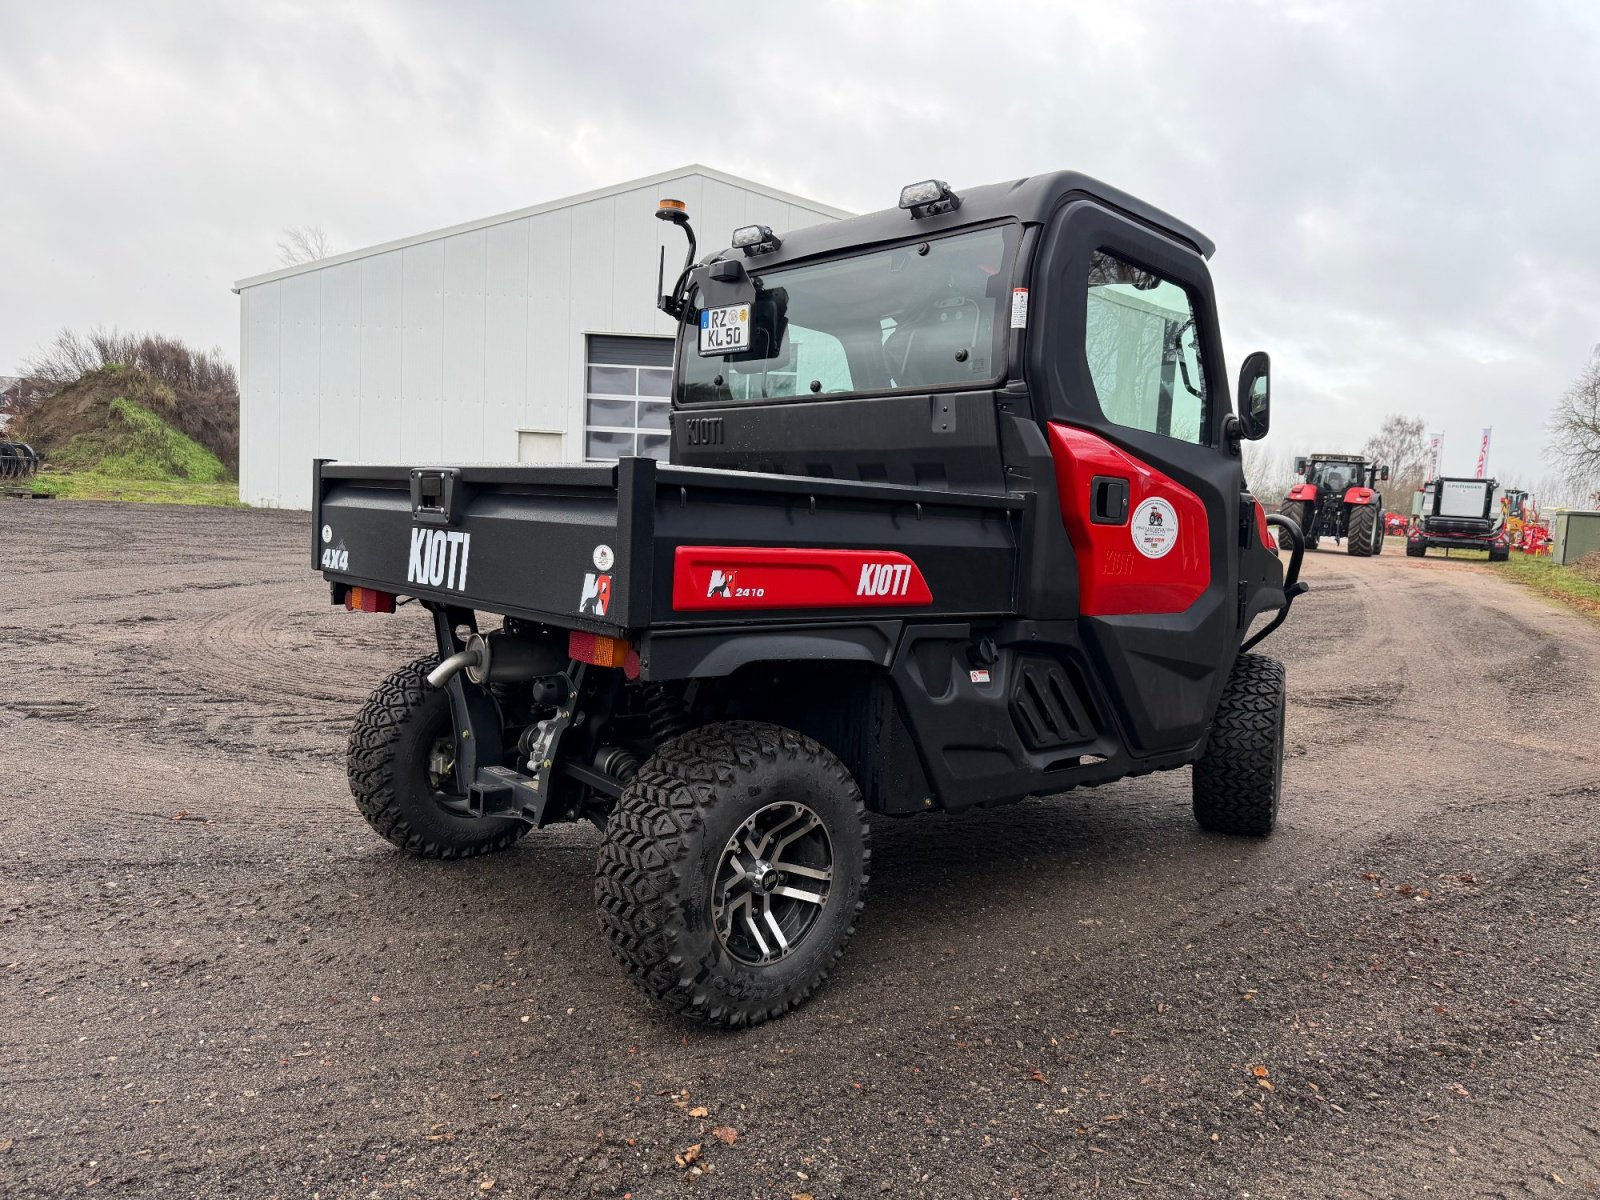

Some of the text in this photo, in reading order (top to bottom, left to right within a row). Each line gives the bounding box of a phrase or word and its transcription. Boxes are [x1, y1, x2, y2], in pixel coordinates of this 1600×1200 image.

[711, 309, 727, 329] RZ
[708, 327, 741, 348] KL 50
[686, 417, 724, 446] KIOTI
[407, 527, 471, 592] KIOTI
[1101, 550, 1135, 576] KIOTI
[856, 563, 912, 596] KIOTI
[735, 588, 764, 598] 2410
